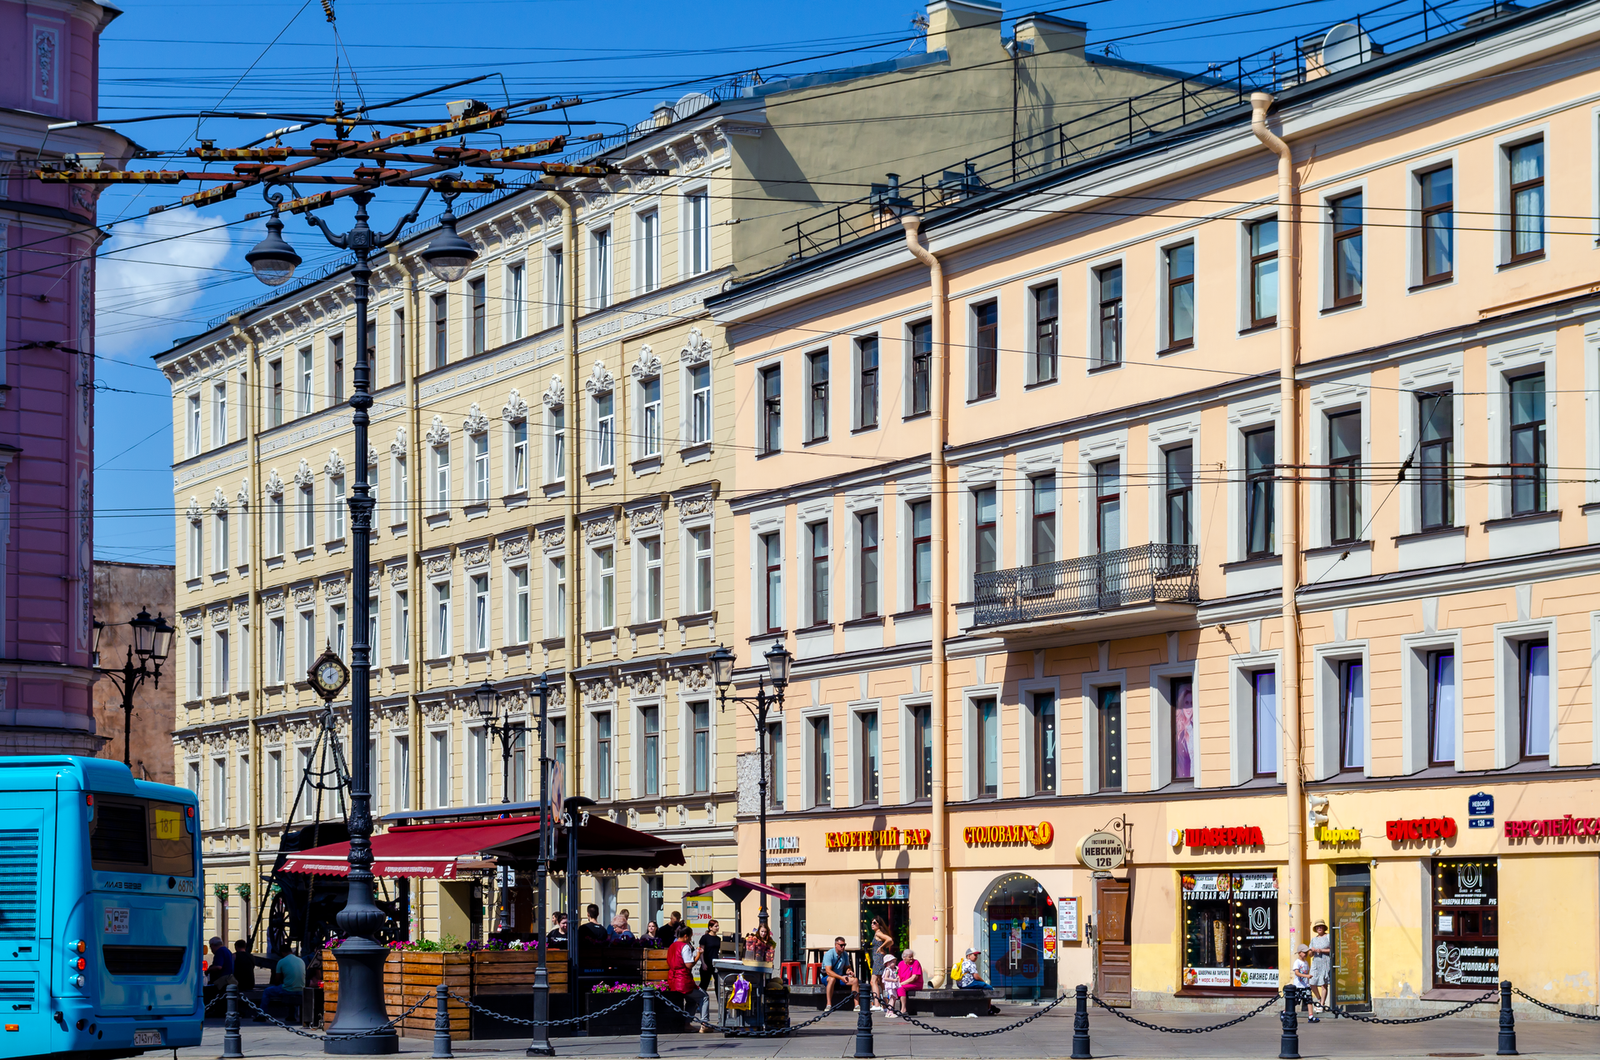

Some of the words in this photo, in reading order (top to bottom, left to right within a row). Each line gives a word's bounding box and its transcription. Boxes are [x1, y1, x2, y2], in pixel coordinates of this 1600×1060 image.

[160, 818, 173, 834] 181
[1386, 817, 1456, 841] БИСТРО
[825, 827, 900, 848] КАФЕТЕРИЙ
[903, 829, 930, 846] БАР
[963, 825, 1020, 844] СТОЛОВАЯ
[1185, 826, 1264, 847] ШАВЕРМА
[1085, 844, 1122, 856] НЕВСКИЙ
[1096, 858, 1112, 867] 126
[178, 880, 193, 893] 6870
[1183, 891, 1217, 900] СТОЛОВАЯ
[1460, 946, 1484, 956] КОФЕЙНЯ
[1461, 962, 1489, 971] СТОЛОВАЯ
[1249, 972, 1268, 980] БИЗНЕС
